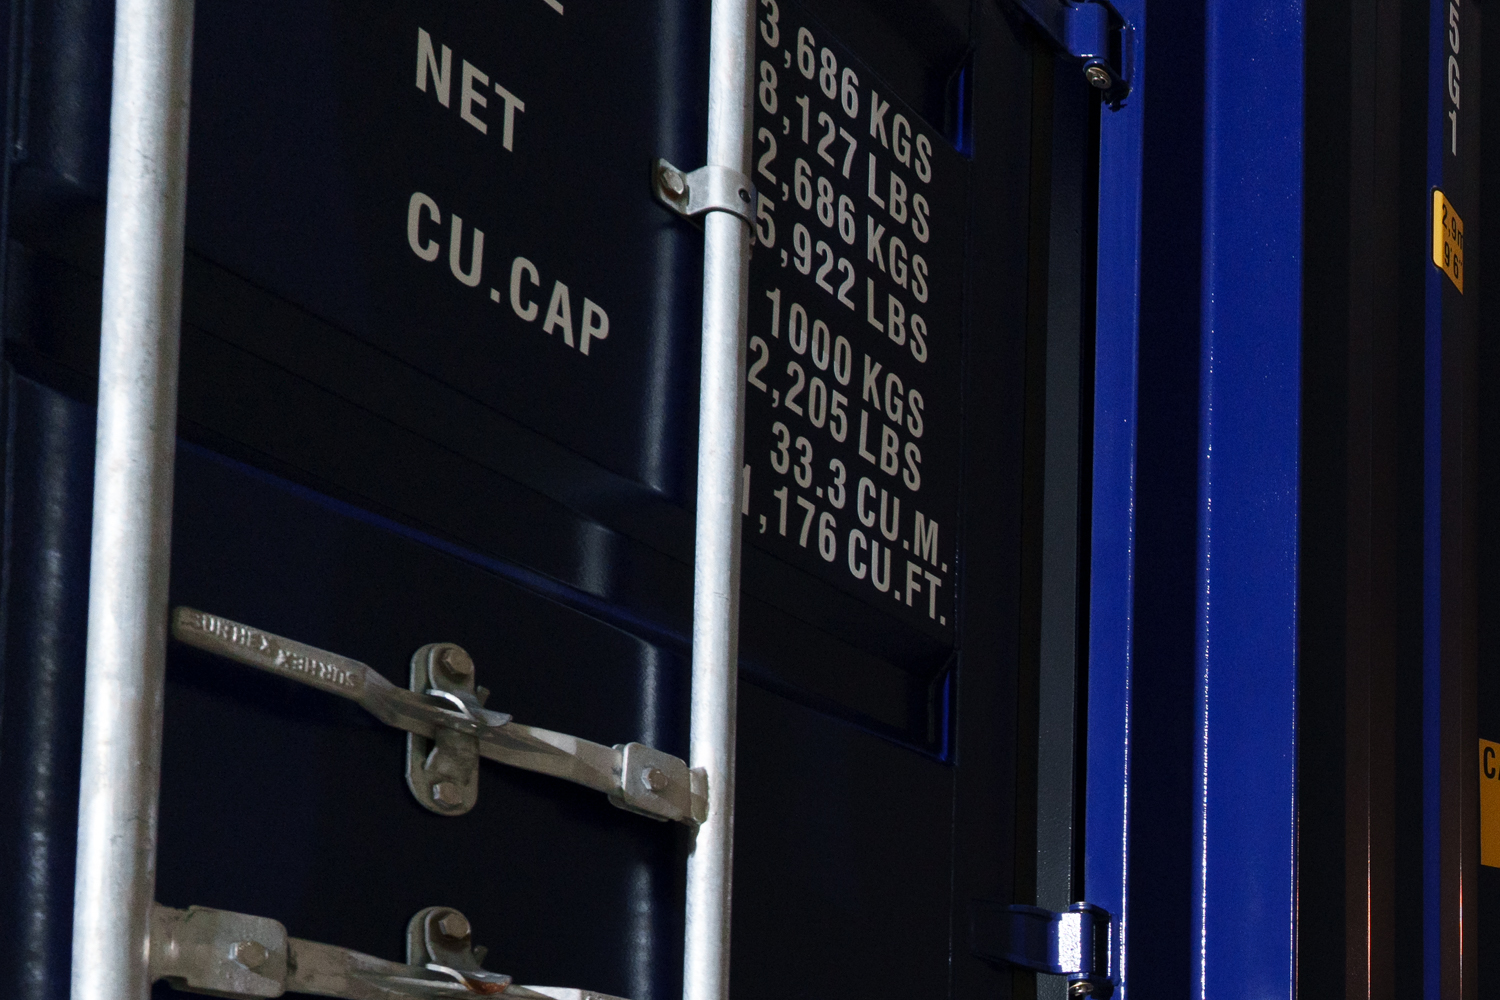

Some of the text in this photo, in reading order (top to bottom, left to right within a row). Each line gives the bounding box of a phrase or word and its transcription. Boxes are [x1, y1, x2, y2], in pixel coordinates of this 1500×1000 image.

[415, 26, 526, 153] NET
[758, 60, 930, 244] 8,127 LBS
[759, 0, 932, 184] 3,686 KGS
[1447, 0, 1461, 156] 5G1
[406, 191, 610, 357] CU.CAP
[756, 192, 928, 364] 5,922 LBS
[757, 126, 929, 304] 2,686 KGS
[747, 335, 922, 492] 2,205 LBS
[766, 287, 925, 439] 1000 KGS
[741, 463, 947, 626] 1,176 CU.FT.
[769, 421, 948, 574] 33.3 CU.M.
